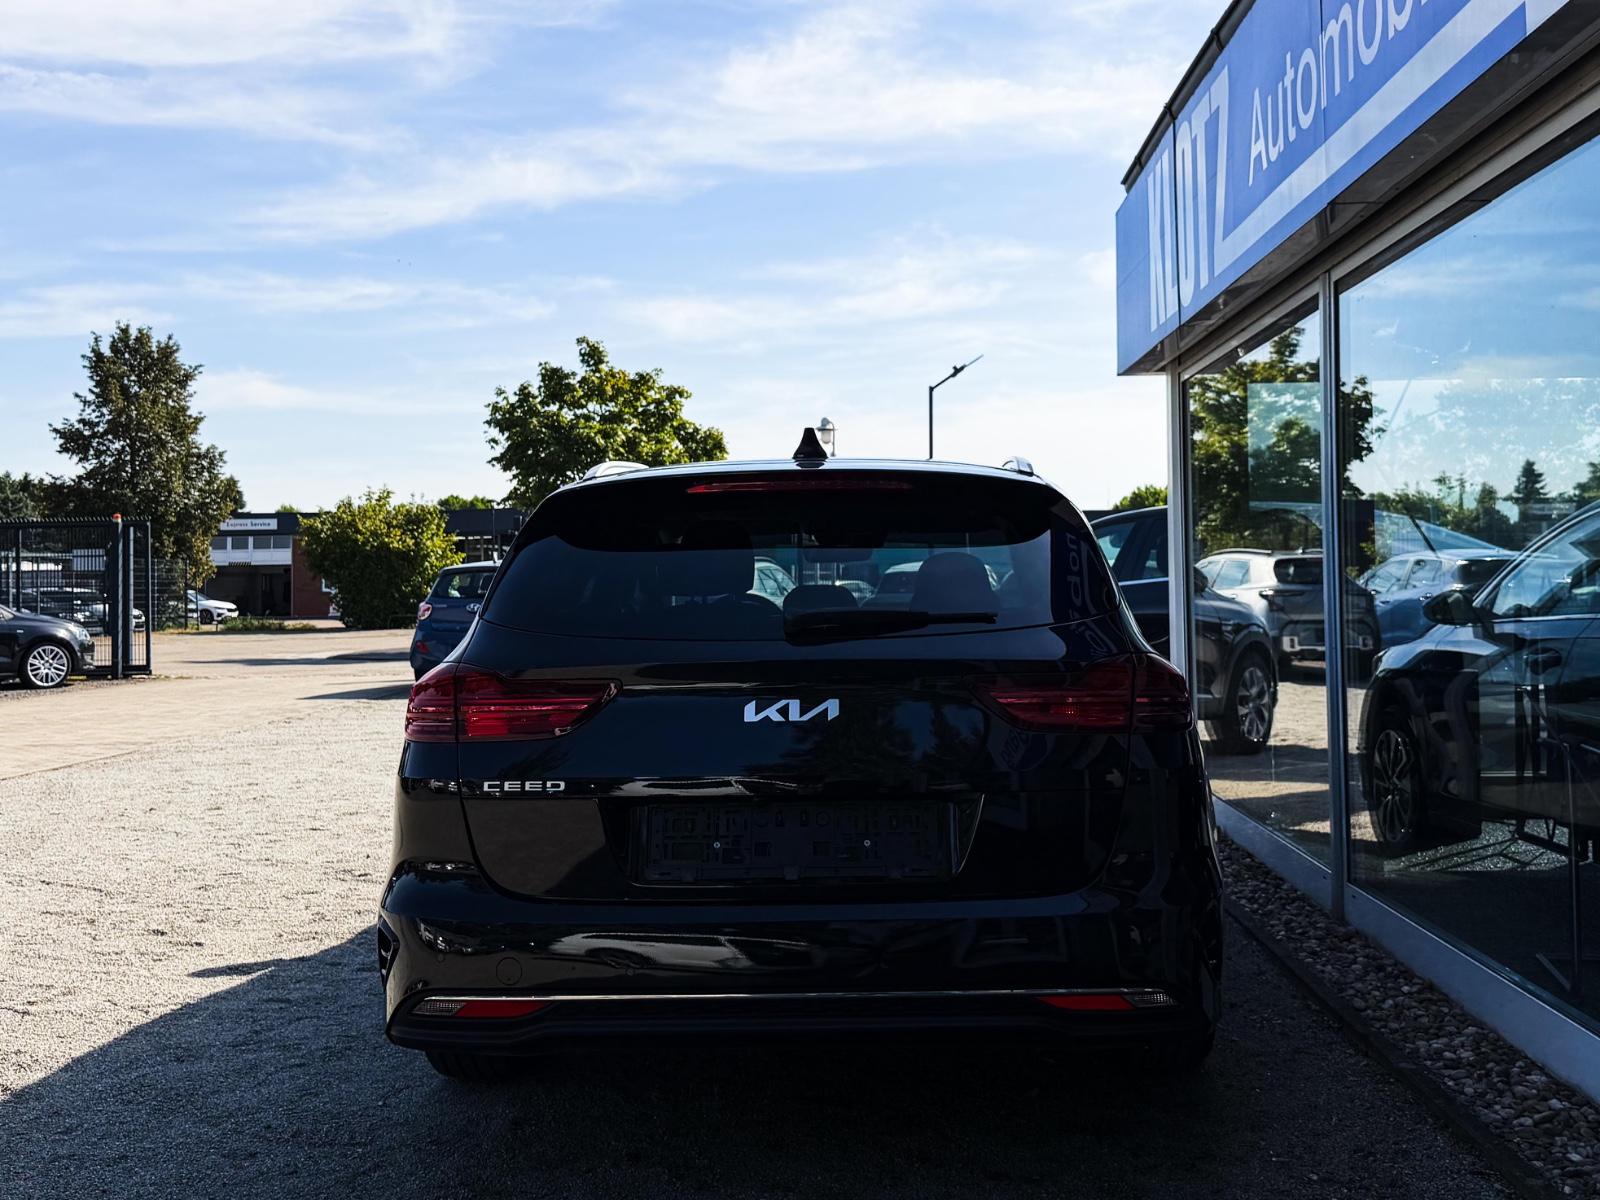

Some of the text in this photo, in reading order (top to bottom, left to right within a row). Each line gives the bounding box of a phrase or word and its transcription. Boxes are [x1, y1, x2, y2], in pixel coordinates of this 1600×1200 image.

[1147, 0, 1428, 332] KLOTZ Automo
[744, 698, 839, 722] KIA
[483, 781, 566, 792] CEED
